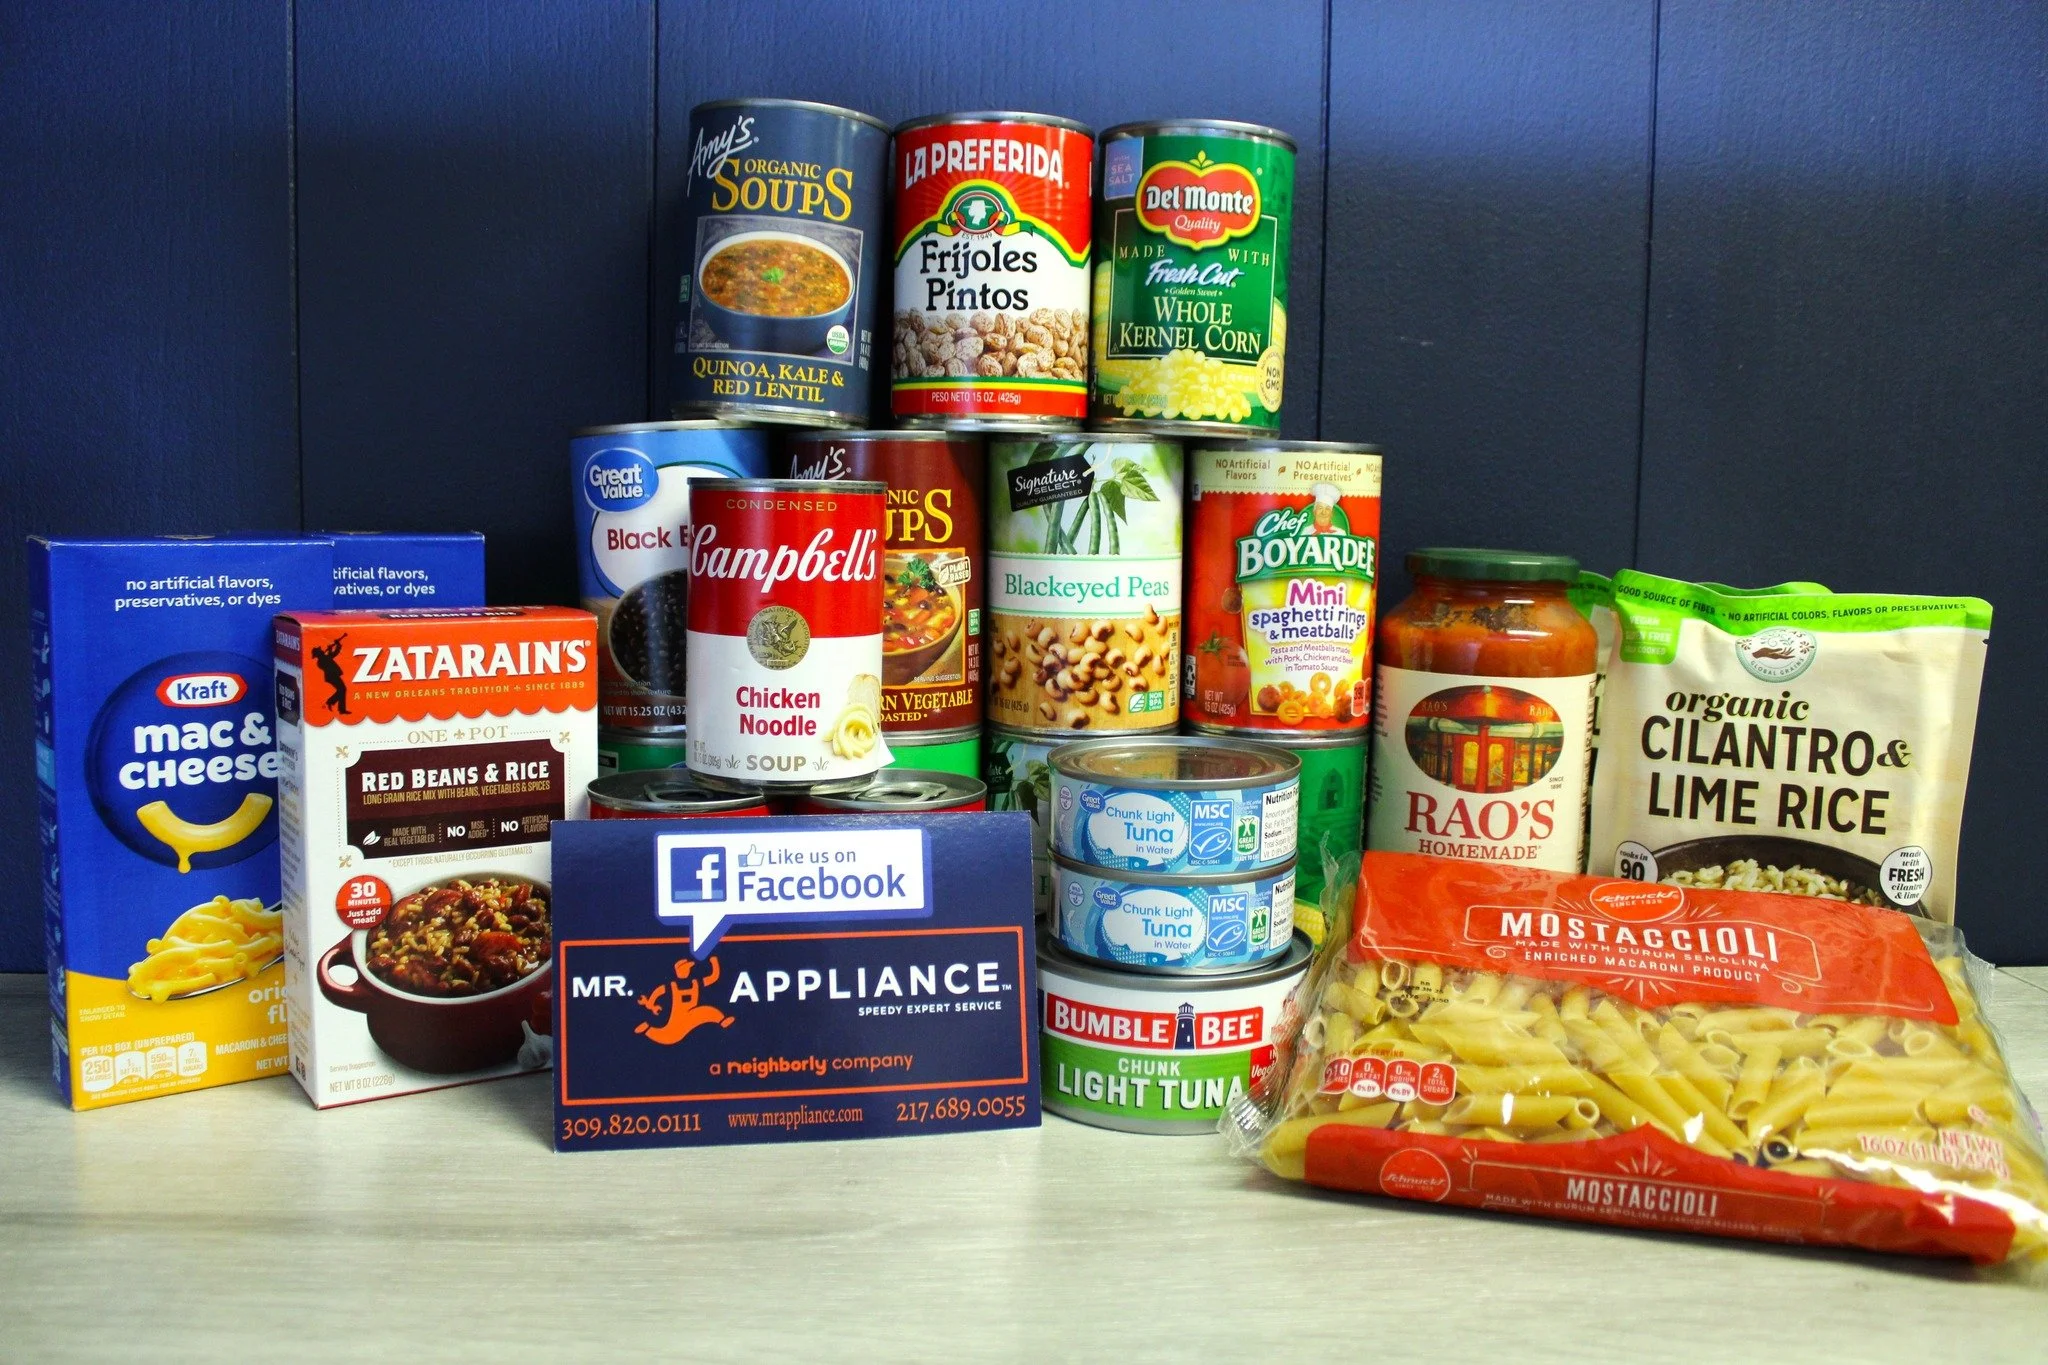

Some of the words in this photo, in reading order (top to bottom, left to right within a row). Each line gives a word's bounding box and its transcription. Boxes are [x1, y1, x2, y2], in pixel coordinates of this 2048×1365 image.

[687, 116, 755, 197] Amy's
[905, 146, 926, 190] LA
[931, 138, 1064, 189] PREFERIDA
[744, 159, 821, 179] ORGANIC
[712, 158, 853, 222] SOUPS
[1146, 186, 1179, 210] Del
[1184, 185, 1253, 214] Monte
[1174, 214, 1221, 233] Quality
[920, 241, 1038, 278] Frijoles
[1119, 245, 1165, 259] MADE
[1228, 248, 1270, 267] WITH
[1145, 258, 1198, 287] Fresh
[1198, 263, 1244, 287] Cut
[926, 278, 1028, 311] Pintos
[1169, 287, 1195, 295] Golden
[1197, 288, 1218, 297] Sweet
[1154, 296, 1232, 325] WHOLE
[1120, 323, 1199, 349] KERNEL
[1205, 325, 1261, 354] CORN
[692, 356, 775, 380] QUINOA,
[778, 364, 828, 384] KALE
[831, 370, 844, 387] &
[712, 378, 749, 395] RED
[755, 382, 824, 403] LENTIL
[931, 391, 949, 402] PESO
[951, 392, 970, 402] NETO
[973, 392, 982, 402] 15
[983, 393, 996, 402] OZ.
[998, 393, 1021, 404] (425g)
[589, 464, 642, 487] Great
[1216, 460, 1228, 468] NO
[1229, 460, 1271, 469] Artificial
[1226, 469, 1257, 480] Flavors
[1296, 461, 1311, 470] NO
[1312, 462, 1351, 471] Artificial
[601, 481, 644, 500] Value
[1015, 466, 1078, 495] Signature
[1033, 480, 1077, 495] SELECT
[726, 499, 837, 512] CONDENSED
[1257, 511, 1307, 537] Chef
[607, 528, 672, 550] Black
[690, 524, 876, 593] Campbell's
[1239, 537, 1375, 578] BOYARDEE
[126, 579, 146, 591] no
[149, 576, 214, 590] artificial
[217, 575, 274, 589] flavors,
[1005, 573, 1120, 603] Blackeyed
[1128, 577, 1169, 598] Peas
[114, 594, 225, 611] preservatives,
[227, 594, 244, 605] or
[247, 592, 281, 607] dyes
[1290, 583, 1343, 606] Mini
[1618, 585, 1640, 597] GOOD
[1644, 590, 1677, 605] SOURCE
[1680, 599, 1690, 607] OF
[1693, 602, 1715, 615] FIBER
[1728, 612, 1740, 621] NO
[1743, 612, 1789, 621] ARTIFICIAL
[1792, 609, 1830, 621] COLORS,
[1832, 606, 1872, 618] FLAVORS
[1875, 605, 1888, 614] OR
[1891, 603, 1967, 613] PRESERVATIVES
[1252, 606, 1334, 628] spaghetti
[1339, 608, 1365, 630] rings
[1270, 630, 1279, 639] &
[1282, 623, 1354, 639] meatballs
[351, 639, 588, 683] ZATARAIN'S
[176, 681, 227, 701] Kraft
[354, 692, 361, 700] A
[366, 691, 389, 699] NEW
[395, 689, 446, 697] ORLEANS
[450, 686, 510, 695] TRADITION
[525, 683, 555, 691] SINCE
[560, 681, 585, 690] 1889
[736, 686, 820, 708] Chicken
[1666, 690, 1810, 723] organic
[133, 720, 233, 755] mac
[239, 713, 272, 745] &
[407, 729, 447, 744] ONE
[468, 726, 508, 740] POT
[739, 714, 816, 736] Noodle
[1641, 715, 1874, 776] CILANTRO
[1877, 739, 1913, 769] &
[746, 755, 806, 772] SOUP
[362, 772, 404, 792] RED
[412, 767, 478, 788] BEANS
[484, 764, 499, 783] &
[505, 761, 549, 781] RICE
[363, 793, 382, 805] LONG
[384, 792, 405, 804] GRAIN
[406, 791, 421, 802] RICE
[423, 790, 436, 801] MIX
[438, 789, 456, 800] WITH
[457, 787, 480, 799] BEANS,
[481, 783, 520, 796] VEGETABLES
[522, 782, 527, 792] &
[528, 780, 550, 791] SPICES
[1648, 772, 1759, 825] LIME
[1777, 783, 1890, 835] RICE
[1106, 806, 1142, 820] Chunk
[1146, 810, 1175, 822] Light
[1194, 804, 1230, 819] MSC
[1405, 791, 1555, 841] RAO'S
[501, 821, 518, 832] NO
[1124, 822, 1173, 843] Tuna
[768, 849, 804, 865] Like
[810, 850, 829, 863] us
[834, 849, 856, 863] on
[1146, 847, 1173, 855] Water
[1419, 839, 1539, 860] HOMEMADE
[738, 865, 906, 902] Facebook
[1888, 867, 1925, 882] FRESH
[350, 882, 377, 898] 30
[1095, 890, 1117, 901] Great
[347, 897, 380, 906] MINUTES
[1123, 903, 1160, 917] Chunk
[1165, 906, 1193, 917] Light
[1212, 897, 1245, 912] MSC
[347, 909, 362, 918] Just
[363, 908, 381, 917] add
[353, 916, 375, 925] meat!
[1142, 919, 1192, 937] Tuna
[1500, 912, 1779, 963] MOSTACCIOLI
[1515, 940, 1560, 948] MADE
[1569, 942, 1610, 952] WITH
[1618, 946, 1676, 960] DURUM
[1684, 953, 1770, 971] SEMOLINA
[1525, 951, 1597, 964] ENRICHED
[1605, 956, 1685, 973] MACARONI
[1693, 965, 1762, 983] PRODUCT
[572, 975, 634, 998] MR.
[729, 961, 1000, 1003] APPLIANCE
[858, 1004, 903, 1016] SPEEDY
[907, 1003, 950, 1014] EXPERT
[955, 1001, 1001, 1012] SERVICE
[1054, 1000, 1169, 1044] BUMBLE
[1202, 1015, 1254, 1045] BEE
[709, 1062, 721, 1075] a
[726, 1058, 828, 1078] neighborly
[832, 1053, 914, 1074] company
[1118, 1057, 1180, 1076] CHUNK
[1058, 1063, 1150, 1107] LIGHT
[1157, 1075, 1243, 1109] TUNA
[562, 1113, 701, 1140] 309.820.0111
[728, 1106, 863, 1130] www.mrappliance.com
[896, 1094, 1026, 1122] 217.689.0055
[1567, 1177, 1719, 1218] MOSTACCIOLI
